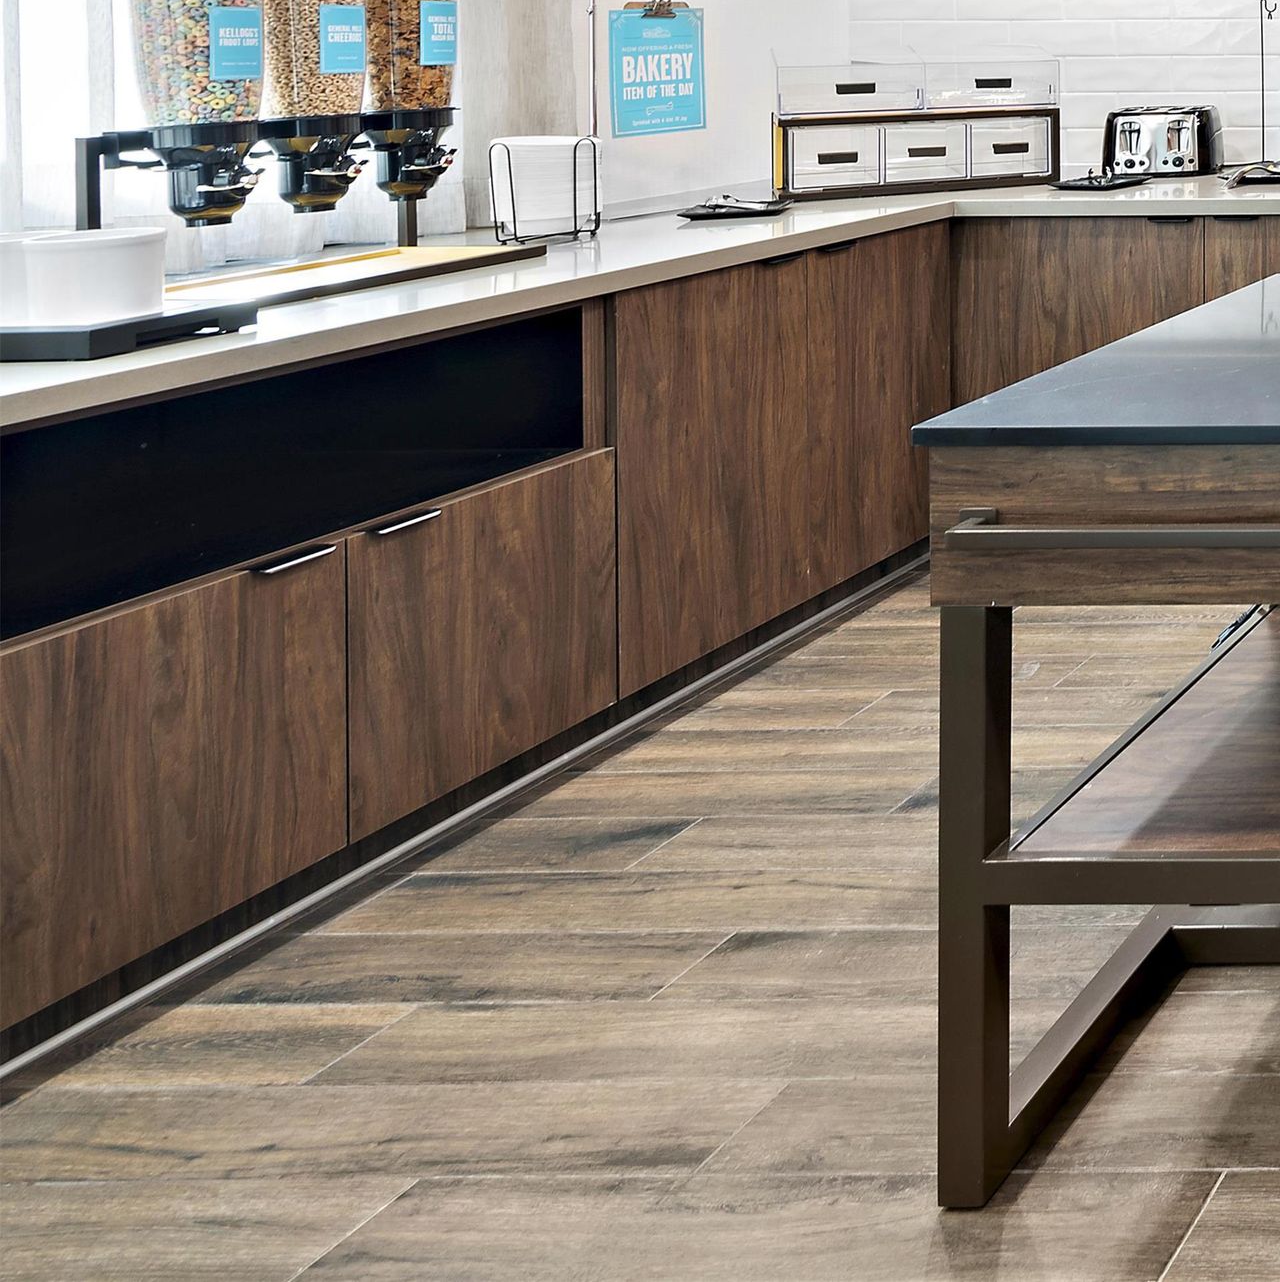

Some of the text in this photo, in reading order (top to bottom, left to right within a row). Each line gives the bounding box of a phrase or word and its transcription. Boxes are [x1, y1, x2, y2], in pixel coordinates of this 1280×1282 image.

[433, 23, 454, 35] TOTAL
[327, 32, 363, 43] CHEERIOS
[622, 52, 694, 83] BAKERY
[623, 82, 694, 100] ITEM OF THE DAY
